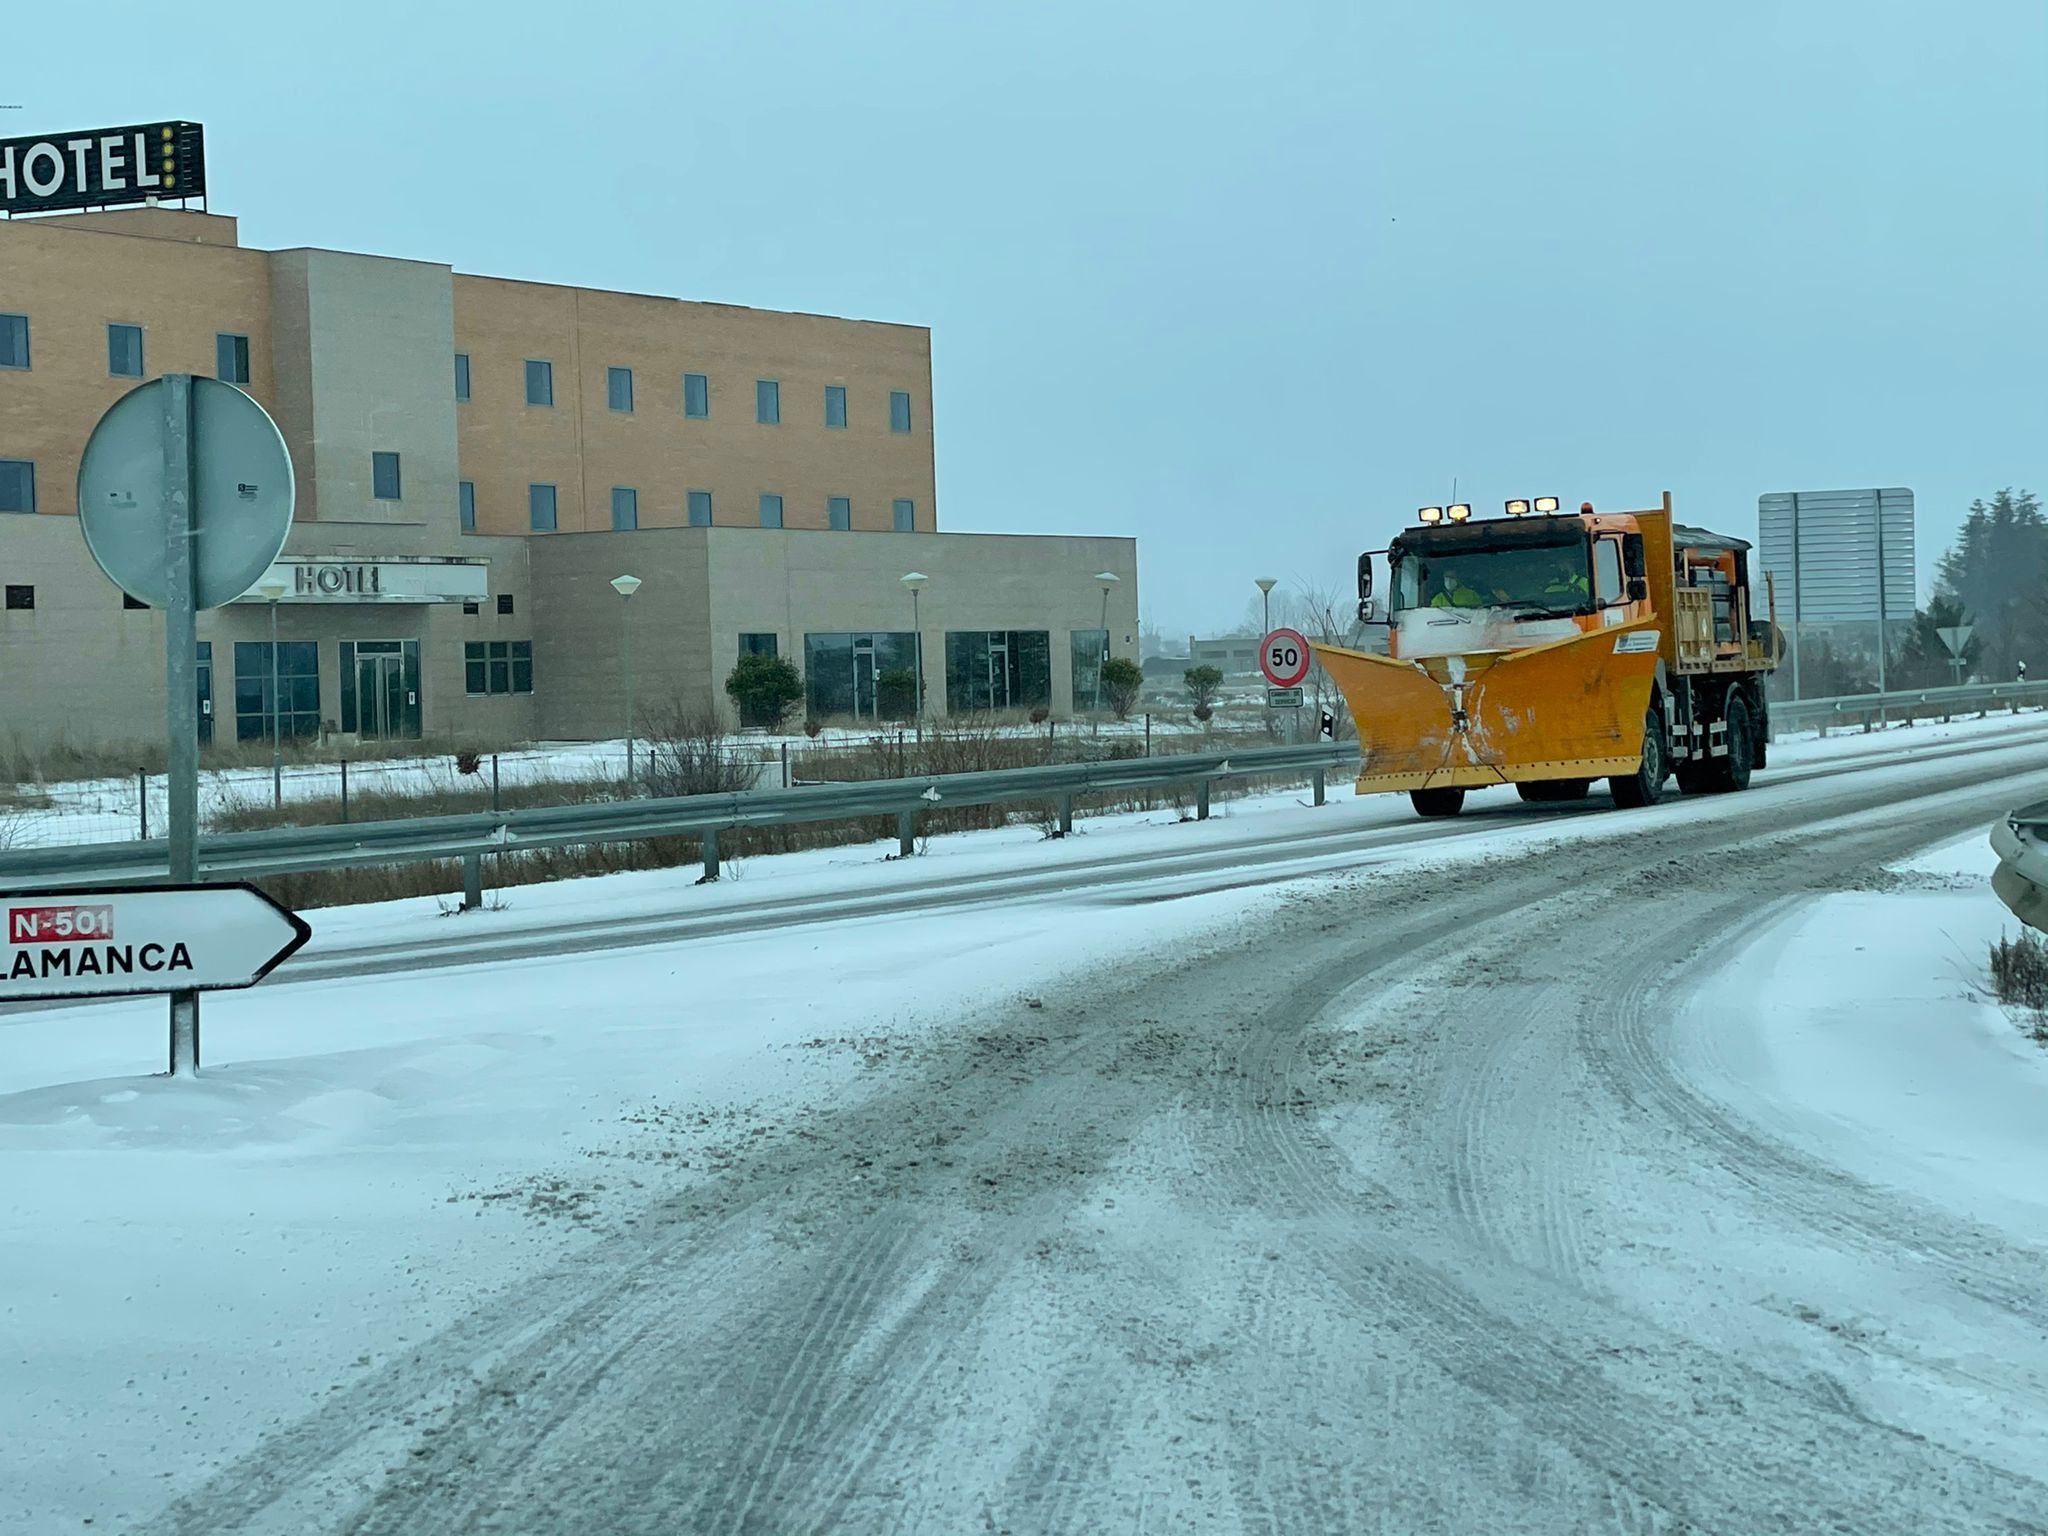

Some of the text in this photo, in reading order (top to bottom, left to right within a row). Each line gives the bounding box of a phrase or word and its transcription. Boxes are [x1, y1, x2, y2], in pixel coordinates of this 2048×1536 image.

[295, 566, 387, 594] HOTEL
[1272, 648, 1298, 667] 50
[15, 910, 110, 938] N-501
